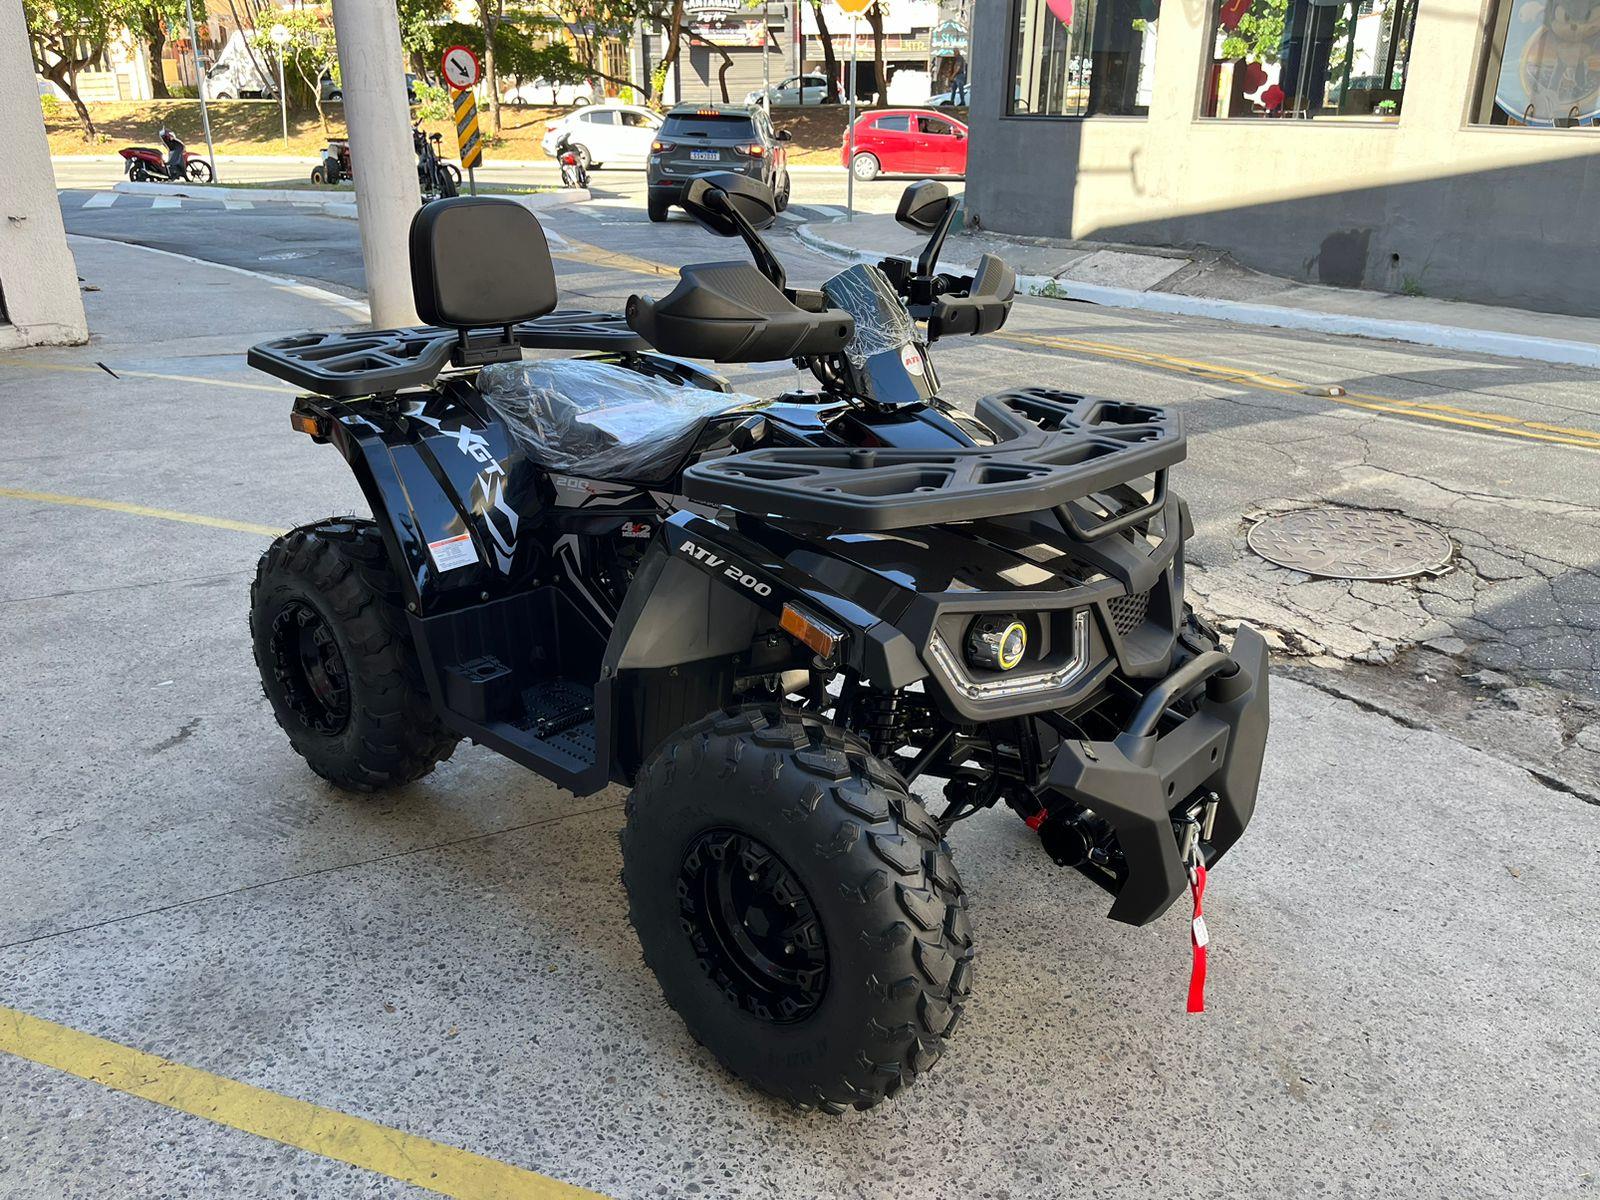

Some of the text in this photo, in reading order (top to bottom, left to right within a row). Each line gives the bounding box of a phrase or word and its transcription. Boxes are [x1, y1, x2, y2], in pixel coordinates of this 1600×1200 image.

[457, 424, 505, 476] XGT
[556, 476, 590, 490] 200
[679, 540, 772, 597] ATV 200
